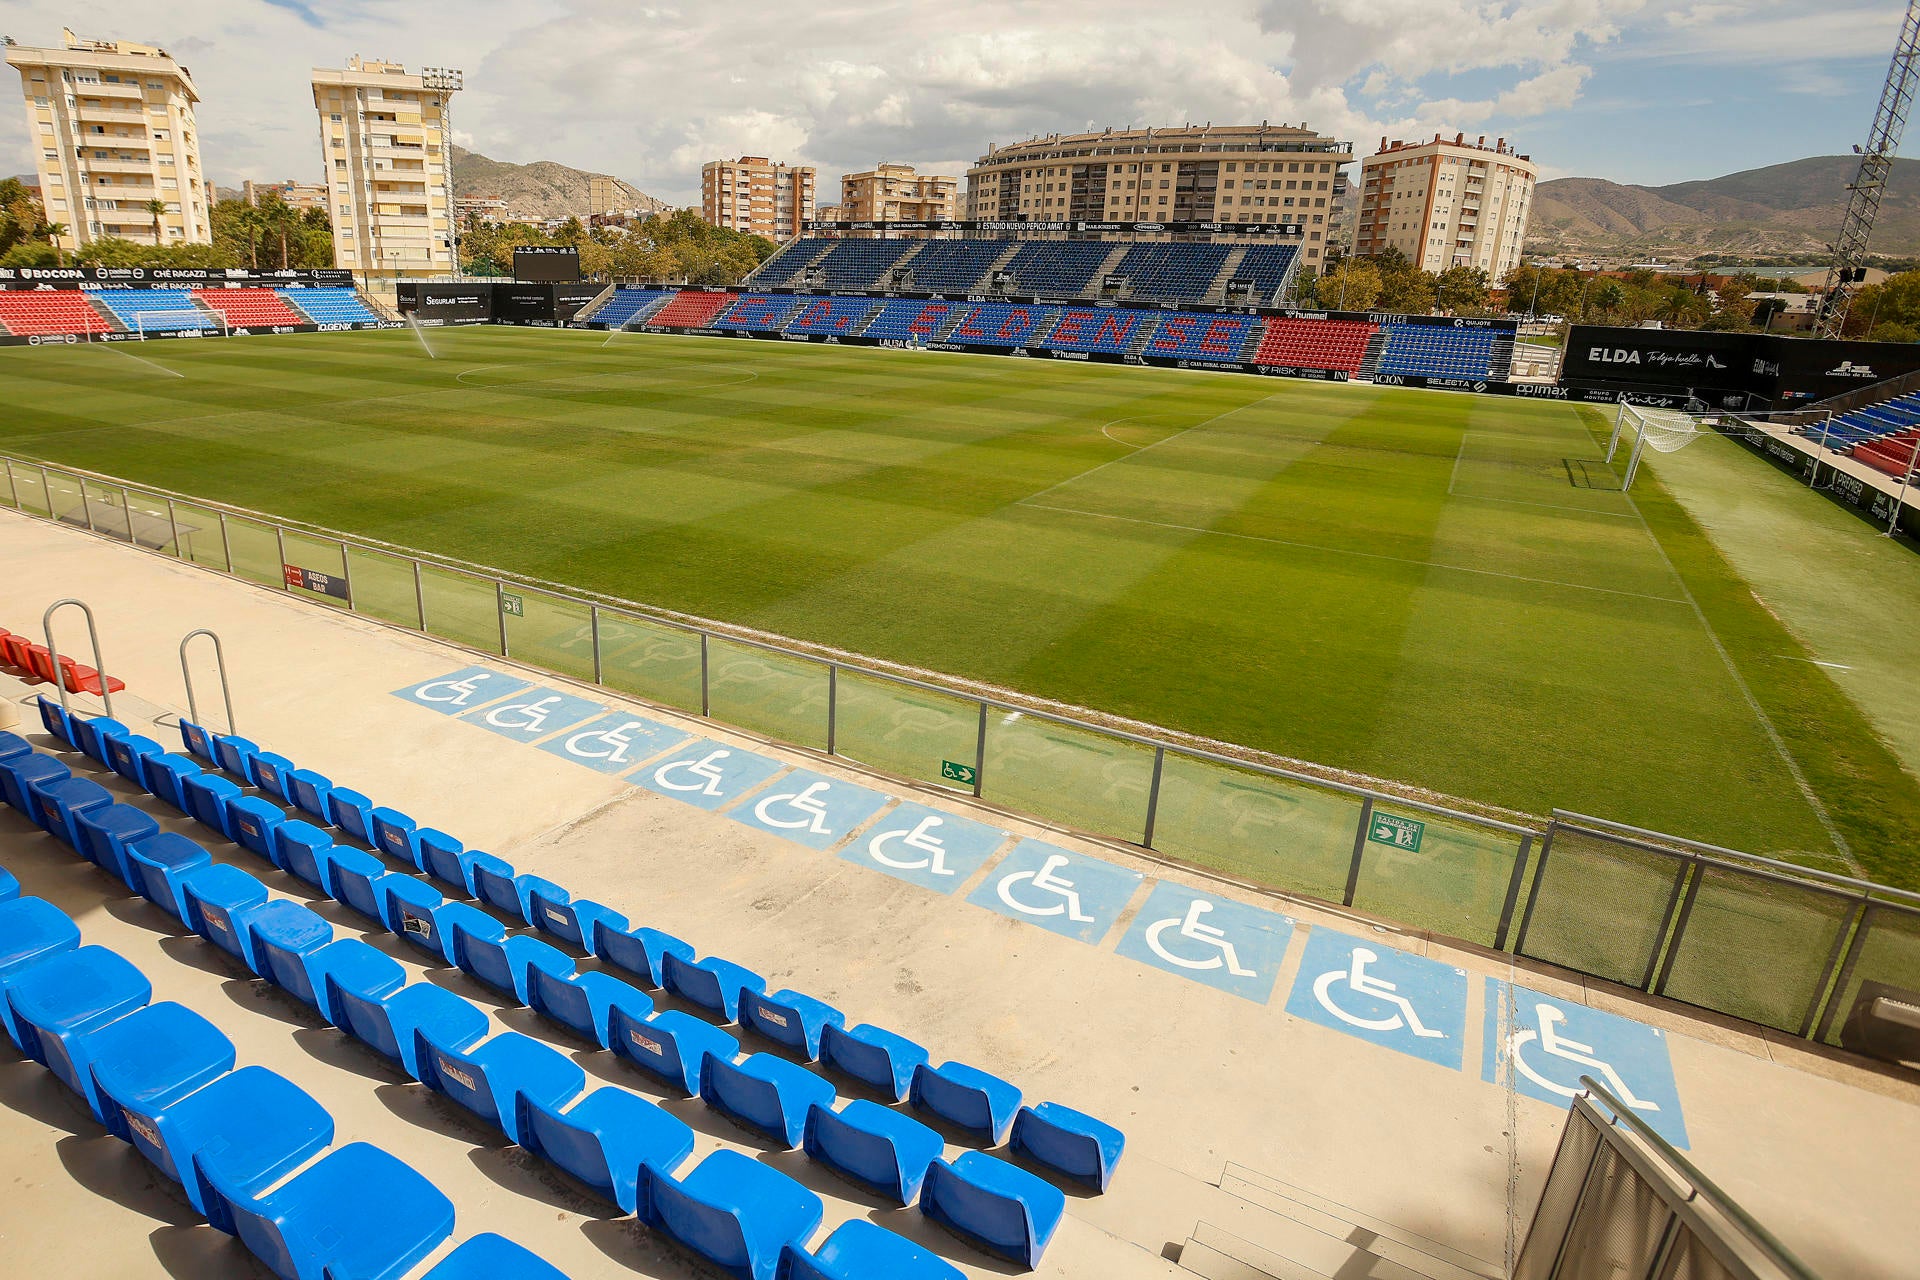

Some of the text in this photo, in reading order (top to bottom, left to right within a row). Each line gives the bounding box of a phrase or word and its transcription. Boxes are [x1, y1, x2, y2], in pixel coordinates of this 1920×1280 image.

[983, 222, 1064, 230] ESTADIO NUEVO PEPICO AMAT
[32, 269, 85, 279] BOCOPA
[172, 269, 207, 278] RAGAZZI
[169, 282, 203, 290] RAGAZZI
[426, 296, 456, 305] SEGURLAB
[968, 295, 986, 303] ELDA
[1295, 311, 1328, 321] hummel
[787, 333, 809, 341] hummel
[1060, 351, 1089, 361] hummel
[1588, 347, 1641, 365] ELDA
[1426, 377, 1470, 387] SELECTA
[1837, 473, 1863, 497] PREMIER
[308, 571, 329, 584] ASEOS
[312, 582, 326, 593] BAR
